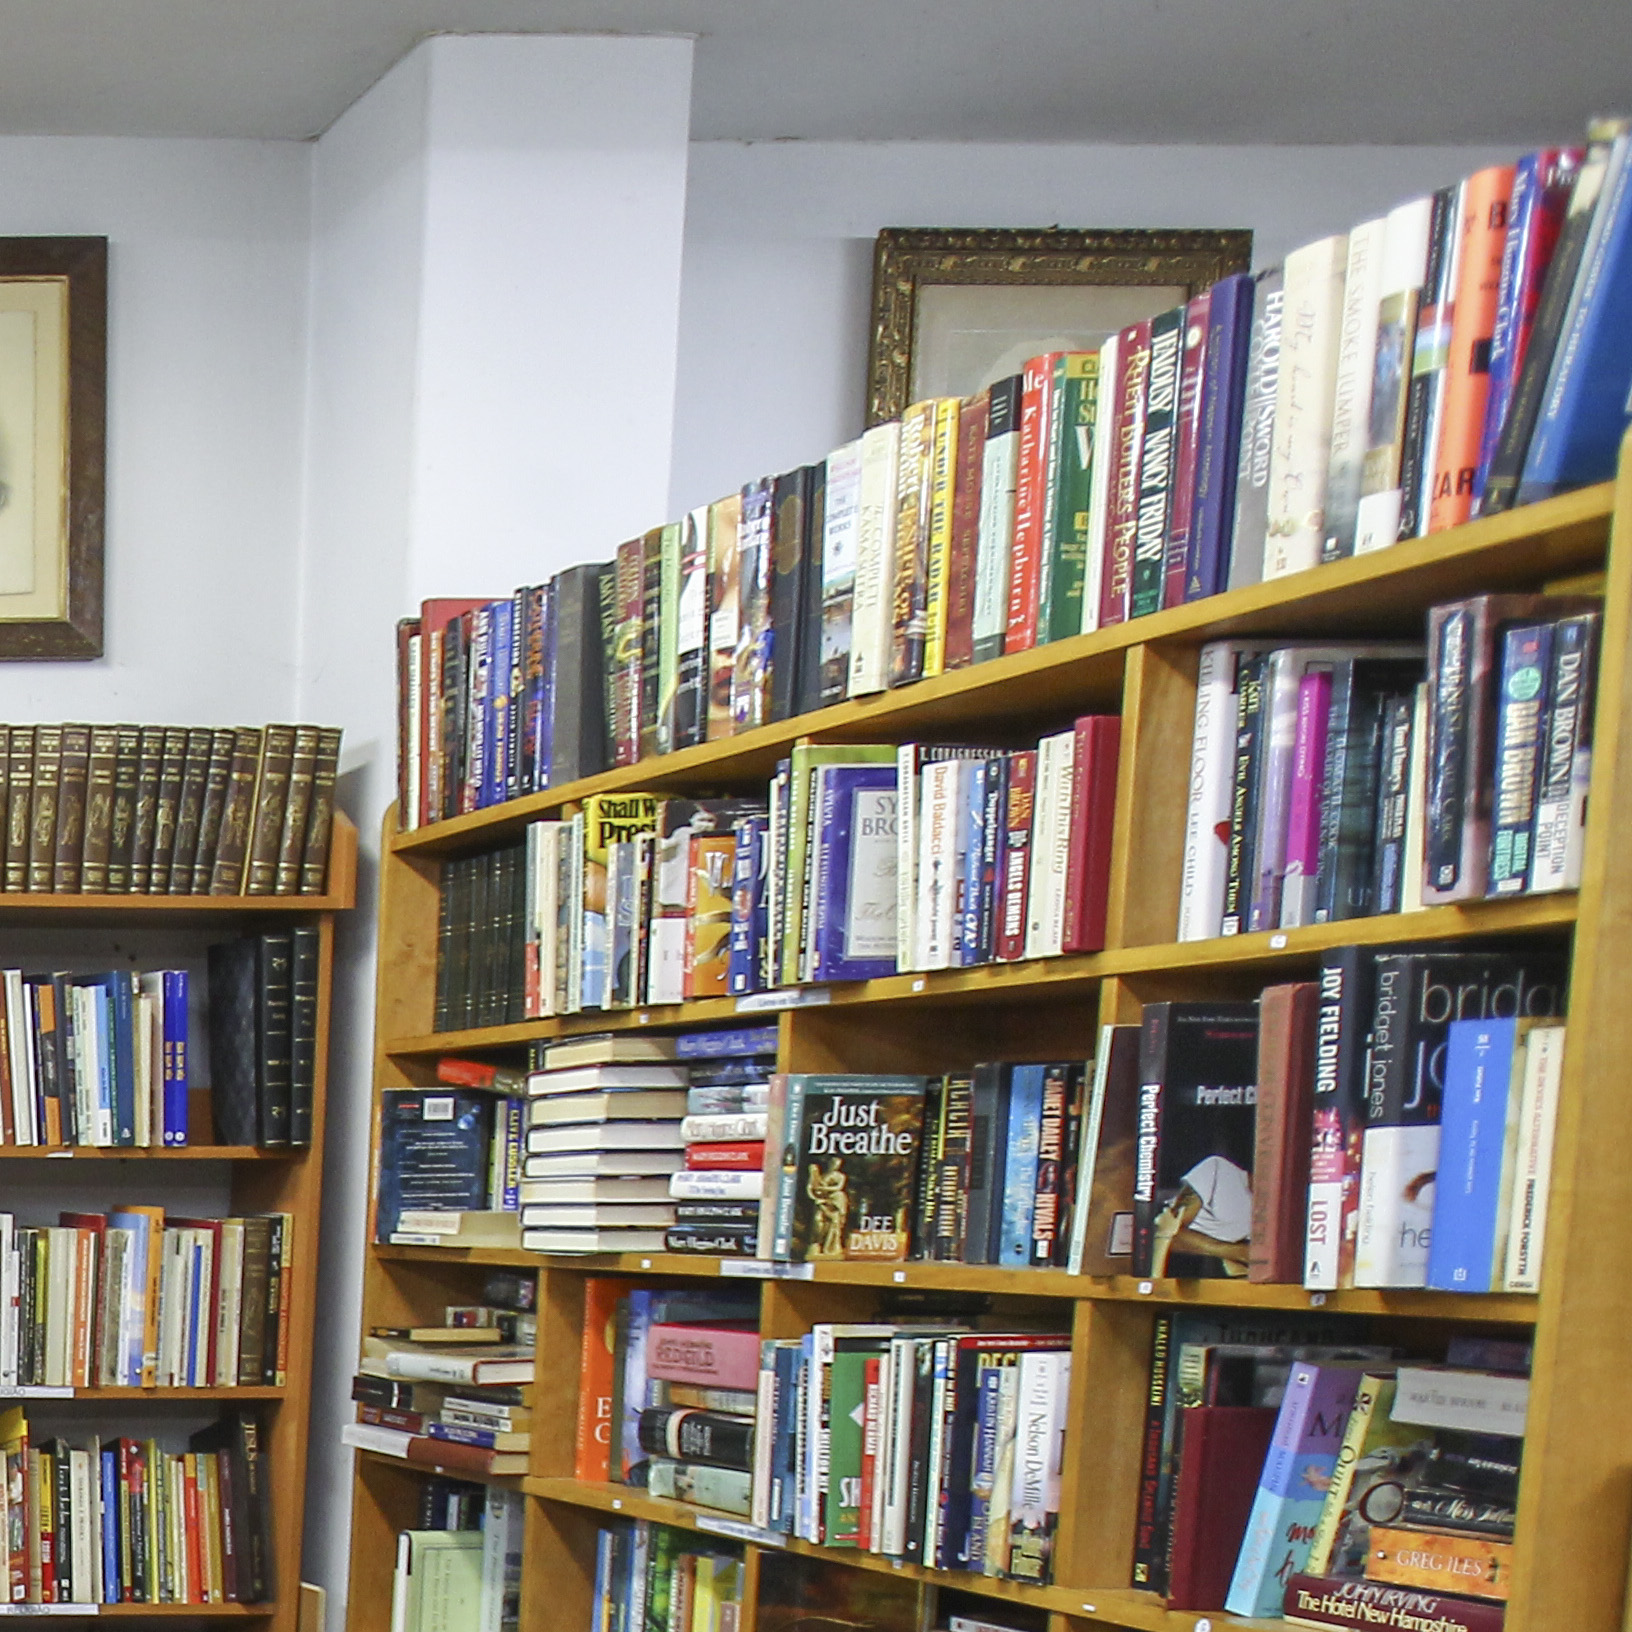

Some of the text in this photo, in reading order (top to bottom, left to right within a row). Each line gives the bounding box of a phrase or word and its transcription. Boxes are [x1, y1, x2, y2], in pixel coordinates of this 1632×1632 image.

[1342, 280, 1367, 369] SMOKE
[1334, 371, 1358, 454] JUMPER
[1142, 426, 1171, 490] NANCY
[1136, 490, 1167, 562] FRIDAY
[1197, 649, 1215, 728] KILLING
[1547, 651, 1582, 797] DAN BROWN
[1189, 730, 1208, 807] FLOOR
[1497, 701, 1539, 826] DAN BROWN
[1496, 829, 1515, 881] FORTRESS
[1536, 811, 1554, 861] POINT
[1552, 803, 1572, 877] DECEPTION
[1182, 843, 1199, 898] CHILD
[1315, 966, 1345, 1095] JOY FIELDING
[1374, 970, 1400, 1057] bridget
[823, 1096, 881, 1128] Just
[1044, 1077, 1065, 1116] JANET
[1195, 1084, 1243, 1106] Perfect
[809, 1121, 913, 1157] Breathe
[1134, 1084, 1161, 1202] Perfect Chemistry
[848, 1231, 900, 1252] DAVIS
[859, 1215, 894, 1234] DEE
[1033, 1193, 1057, 1241] RIVALS
[1308, 1199, 1328, 1247] LOST
[1150, 1319, 1169, 1407] KHALED HOSSEINI
[1021, 1453, 1046, 1511] DeMille
[1396, 1550, 1483, 1576] GREG ILES
[1297, 1588, 1319, 1611] The
[1319, 1592, 1356, 1620] Hotel
[1356, 1598, 1389, 1625] New
[1379, 1589, 1439, 1615] IRVING
